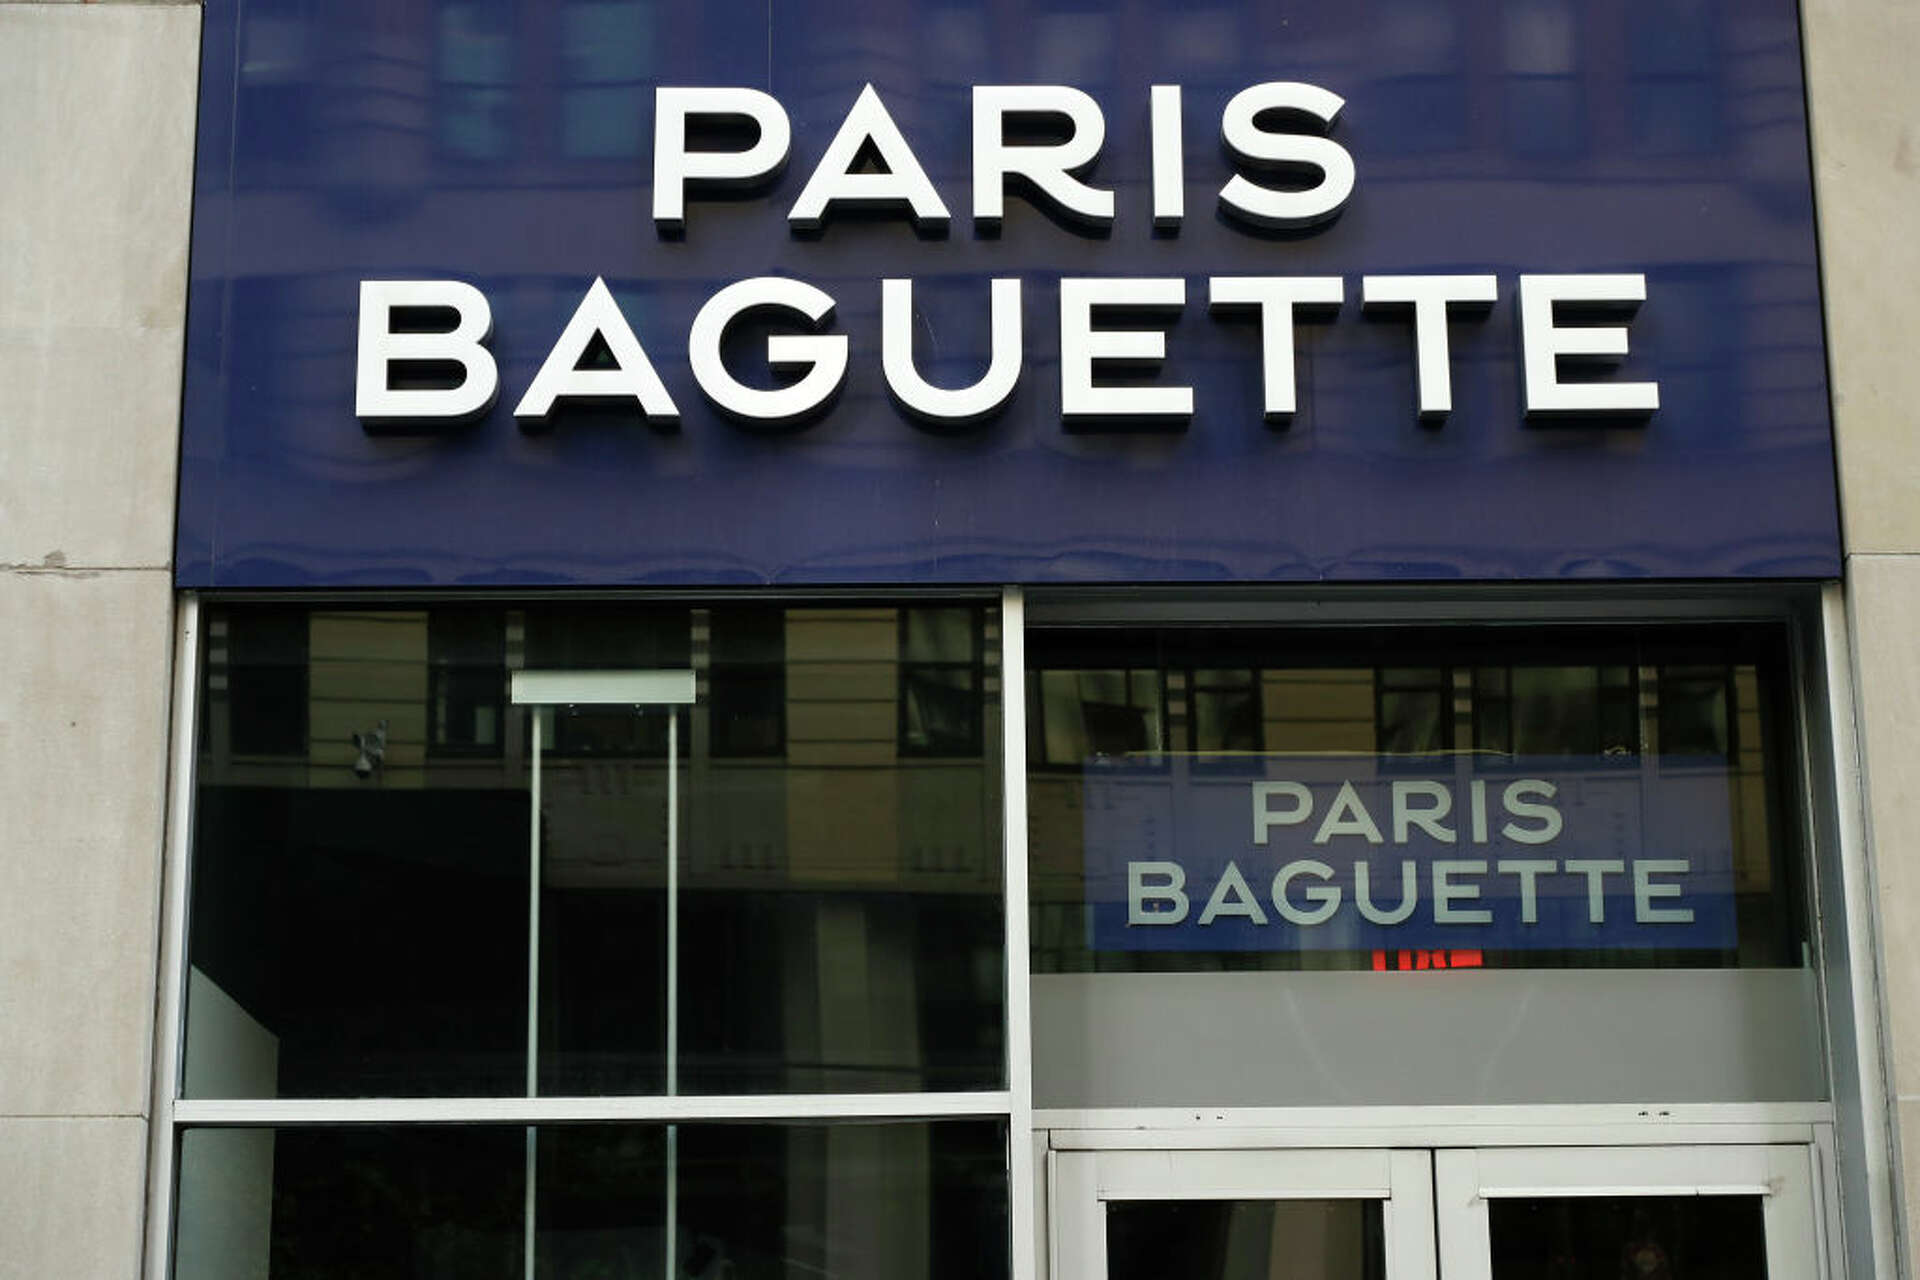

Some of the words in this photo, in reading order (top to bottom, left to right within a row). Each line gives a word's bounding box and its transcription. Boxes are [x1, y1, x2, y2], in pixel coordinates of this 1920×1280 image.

[652, 82, 1356, 224] PARIS
[355, 273, 1660, 421] BAGUETTE
[1252, 779, 1563, 845] PARIS
[1126, 858, 1695, 926] BAGUETTE
